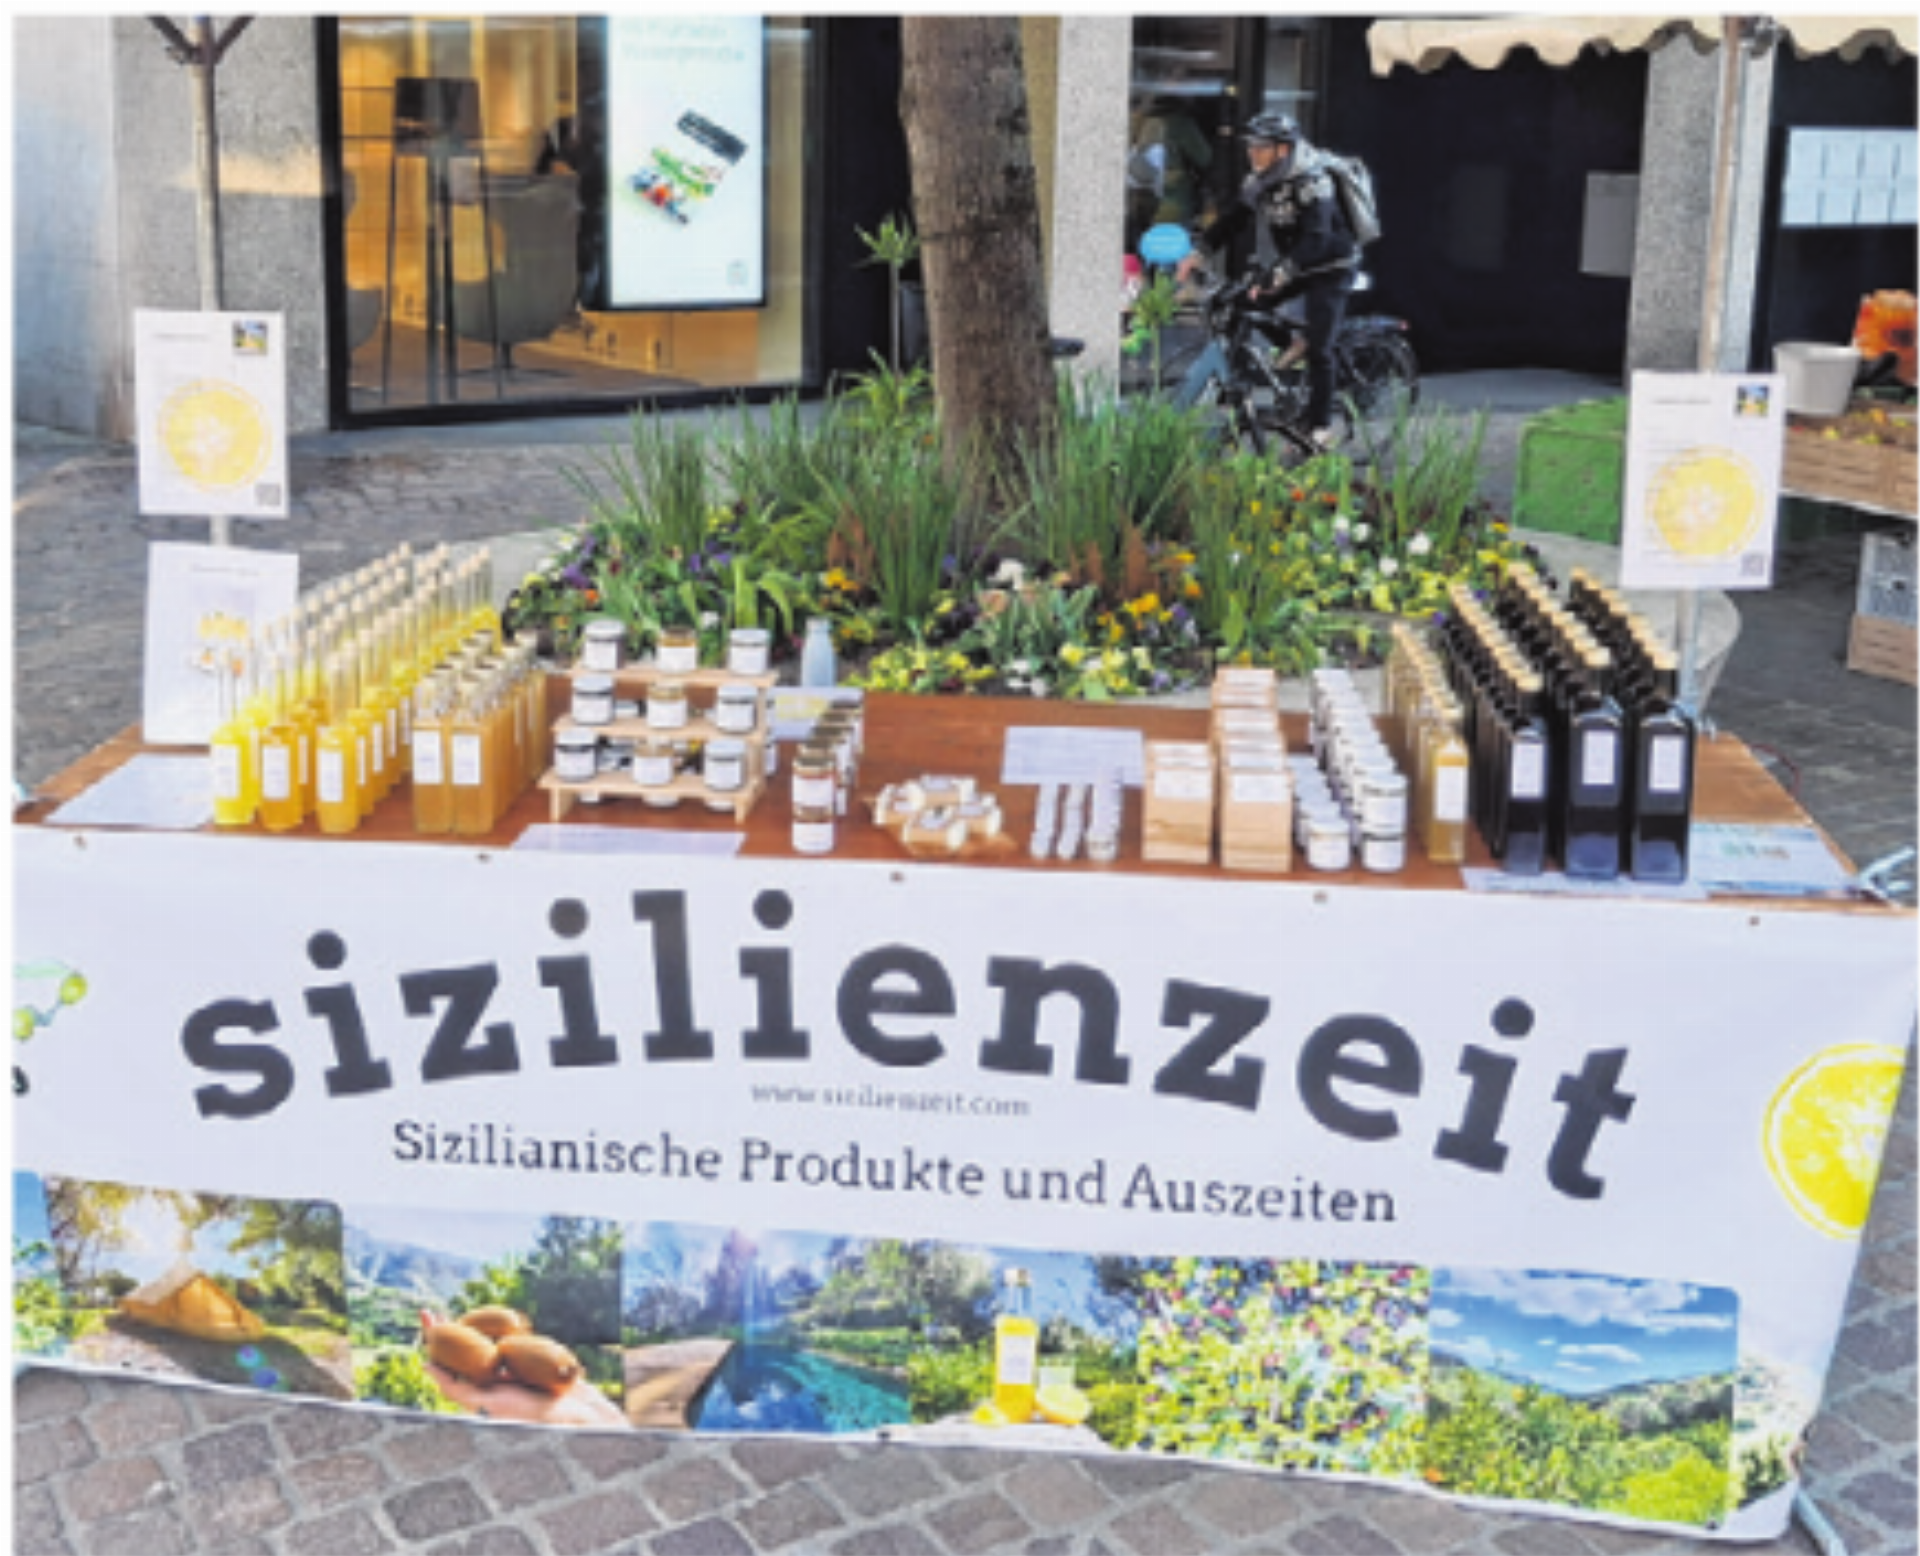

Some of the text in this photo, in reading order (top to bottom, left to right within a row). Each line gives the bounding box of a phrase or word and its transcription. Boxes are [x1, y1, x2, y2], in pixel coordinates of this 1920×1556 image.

[180, 890, 1637, 1201] sizilienzeit
[393, 1121, 1396, 1223] Sizilianische Produkte und Auszeiten
